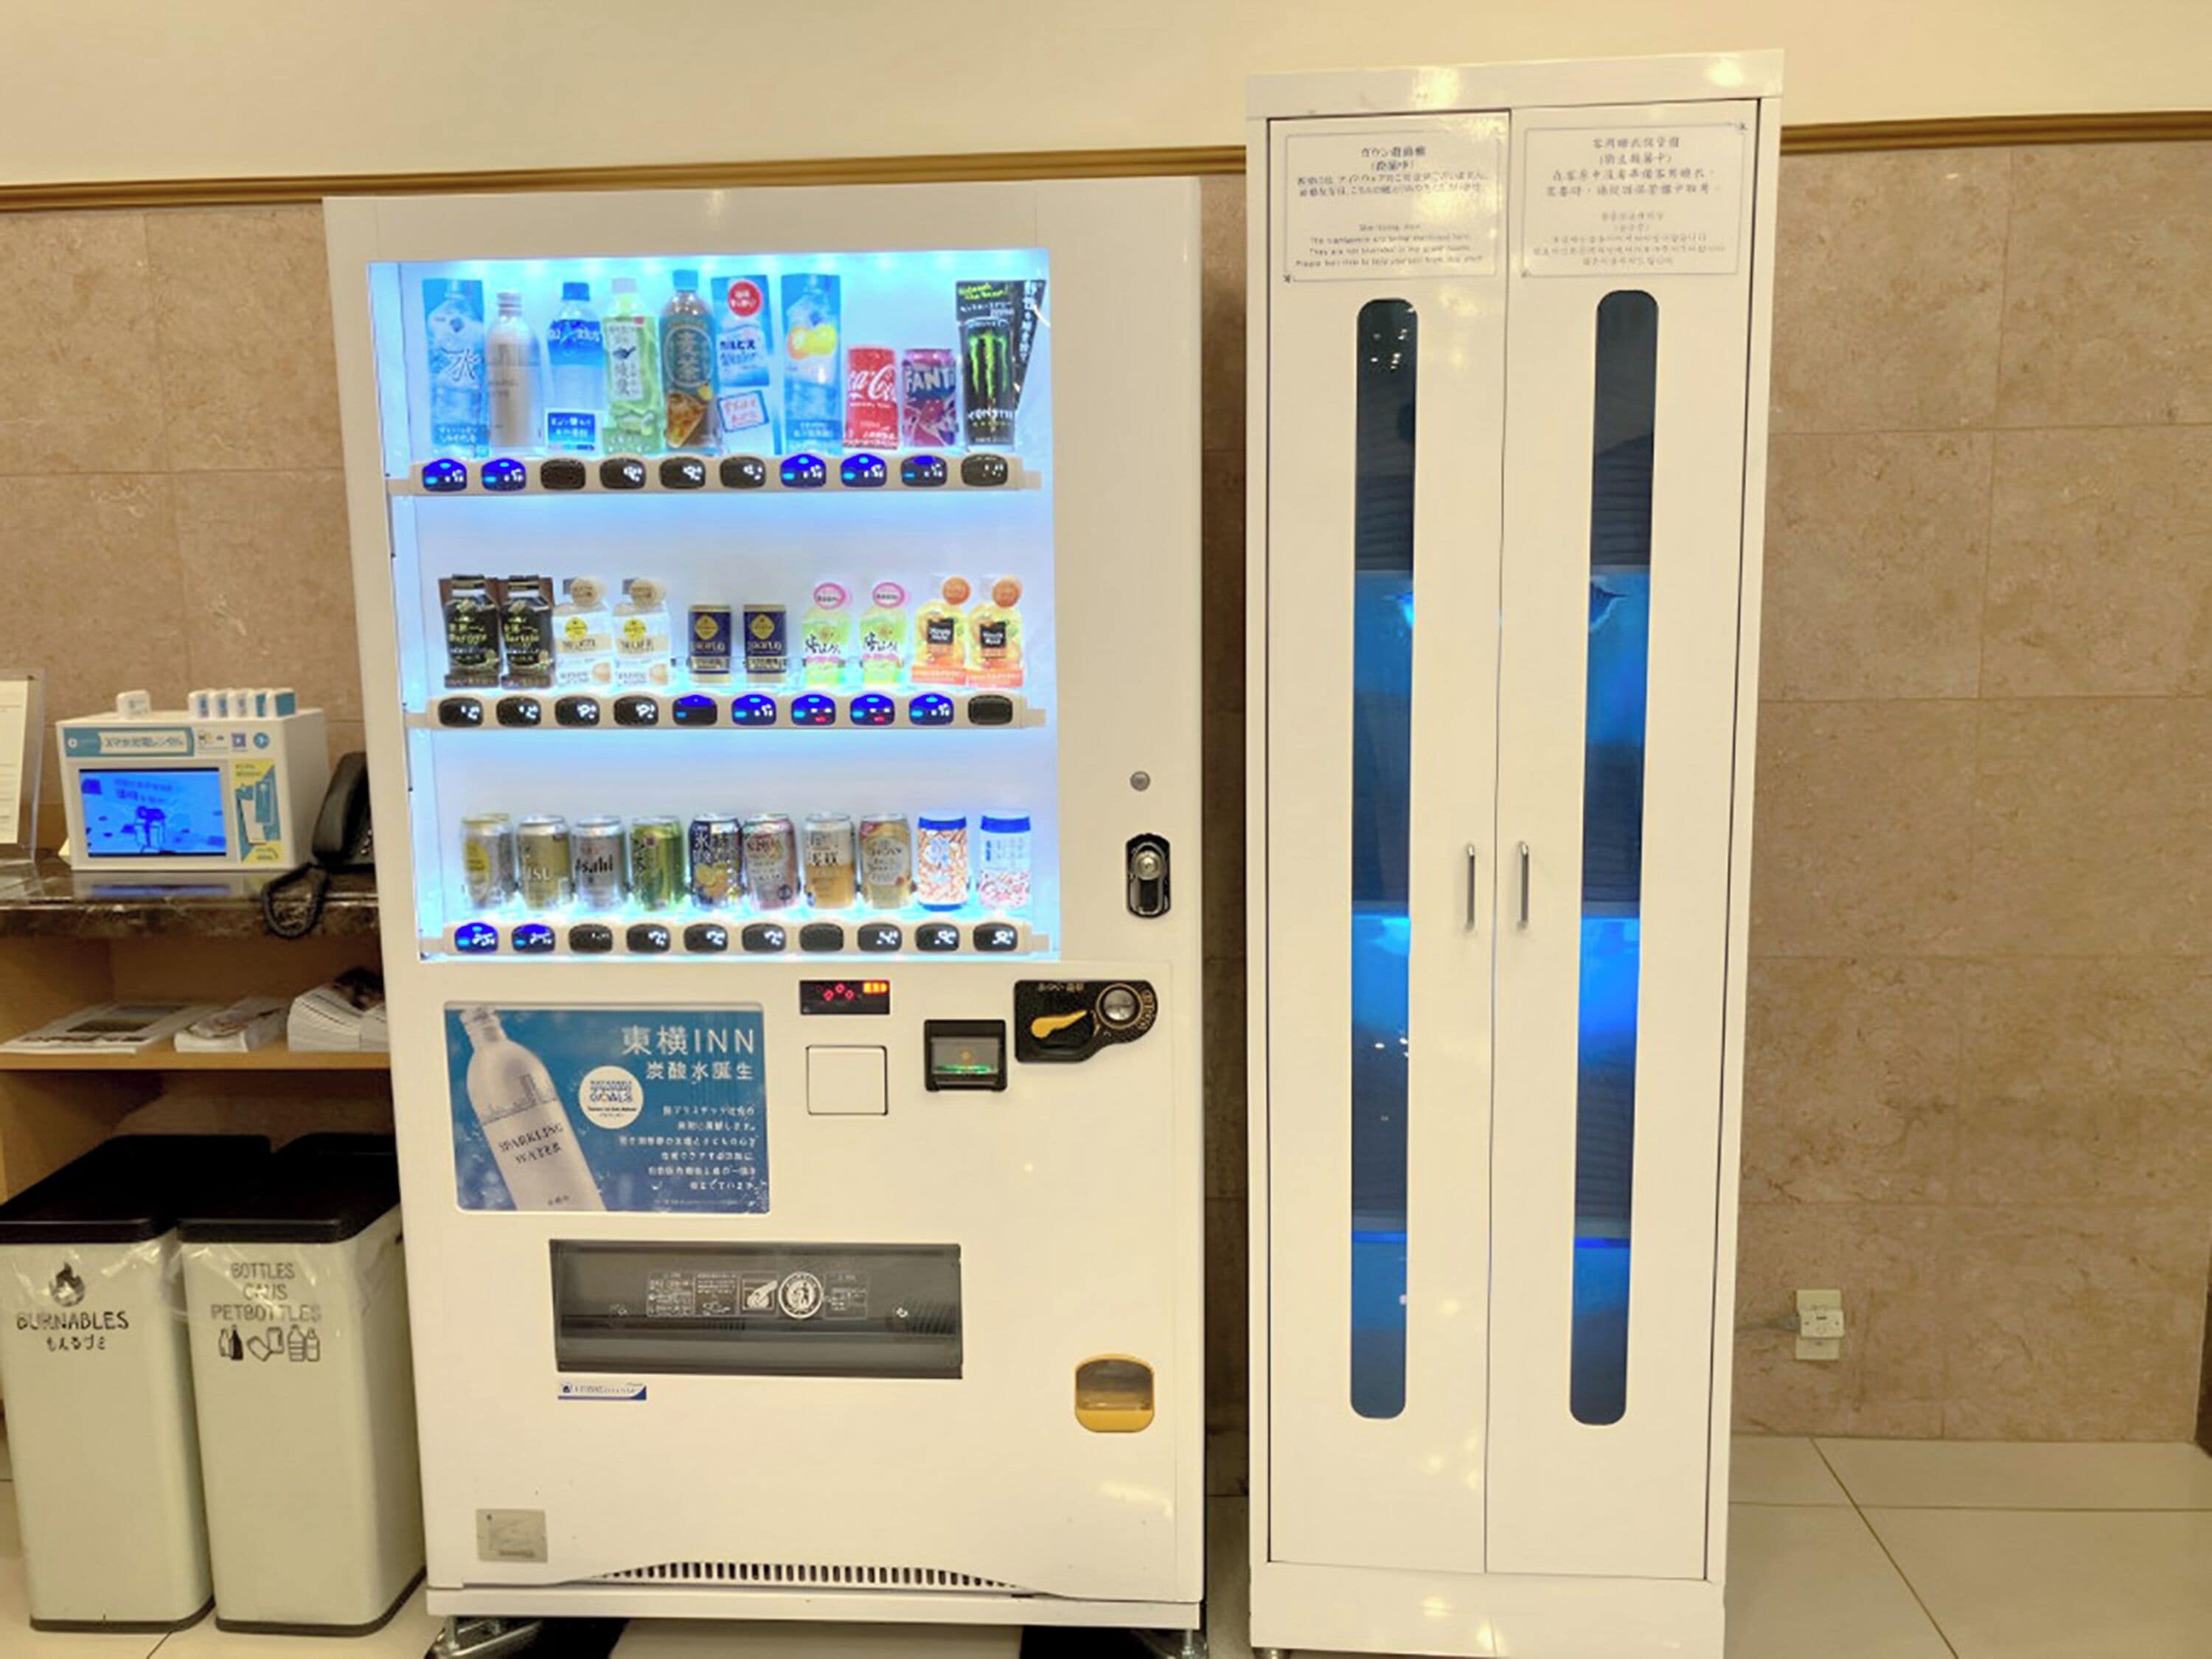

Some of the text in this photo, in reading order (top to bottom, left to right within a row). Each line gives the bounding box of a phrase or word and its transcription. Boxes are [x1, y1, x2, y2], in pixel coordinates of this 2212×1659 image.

[575, 854, 613, 874] Asahi
[622, 1026, 755, 1056] 東横INN
[645, 1060, 754, 1081] 炭酸水誕生
[514, 1141, 561, 1164] WATER
[230, 1262, 296, 1280] BOTTLES
[16, 1310, 130, 1331] BURNABLES
